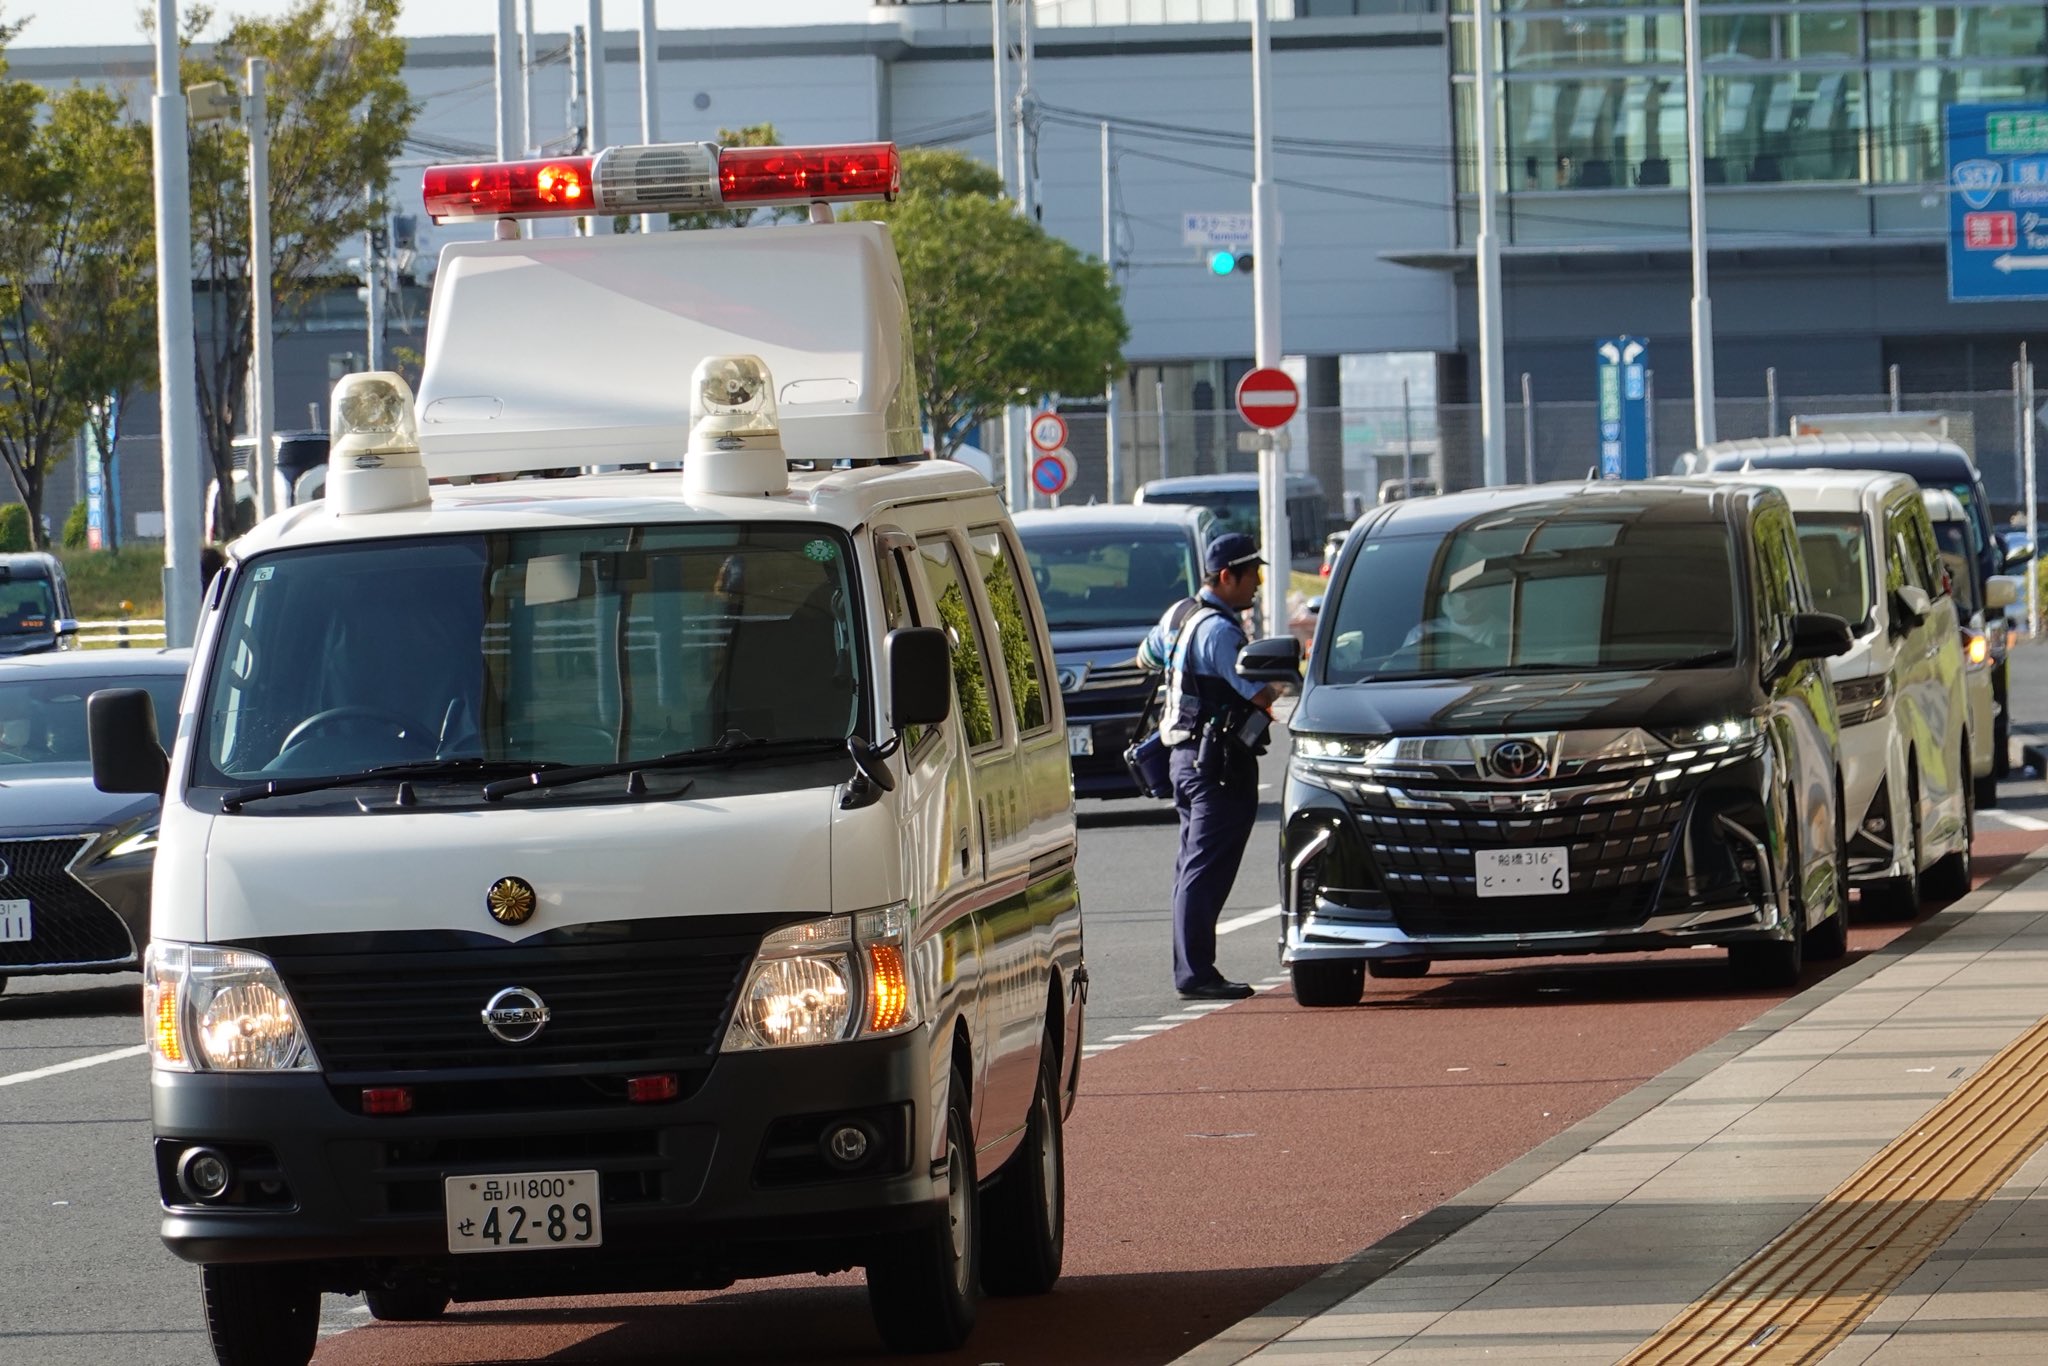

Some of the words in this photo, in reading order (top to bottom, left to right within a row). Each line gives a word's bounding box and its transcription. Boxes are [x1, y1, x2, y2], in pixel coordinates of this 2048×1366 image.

[1964, 168, 1995, 188] 357
[1970, 217, 2010, 245] 第1
[488, 1010, 543, 1022] NISSAN
[483, 1178, 565, 1201] 品川800
[483, 1202, 593, 1245] 42-89
